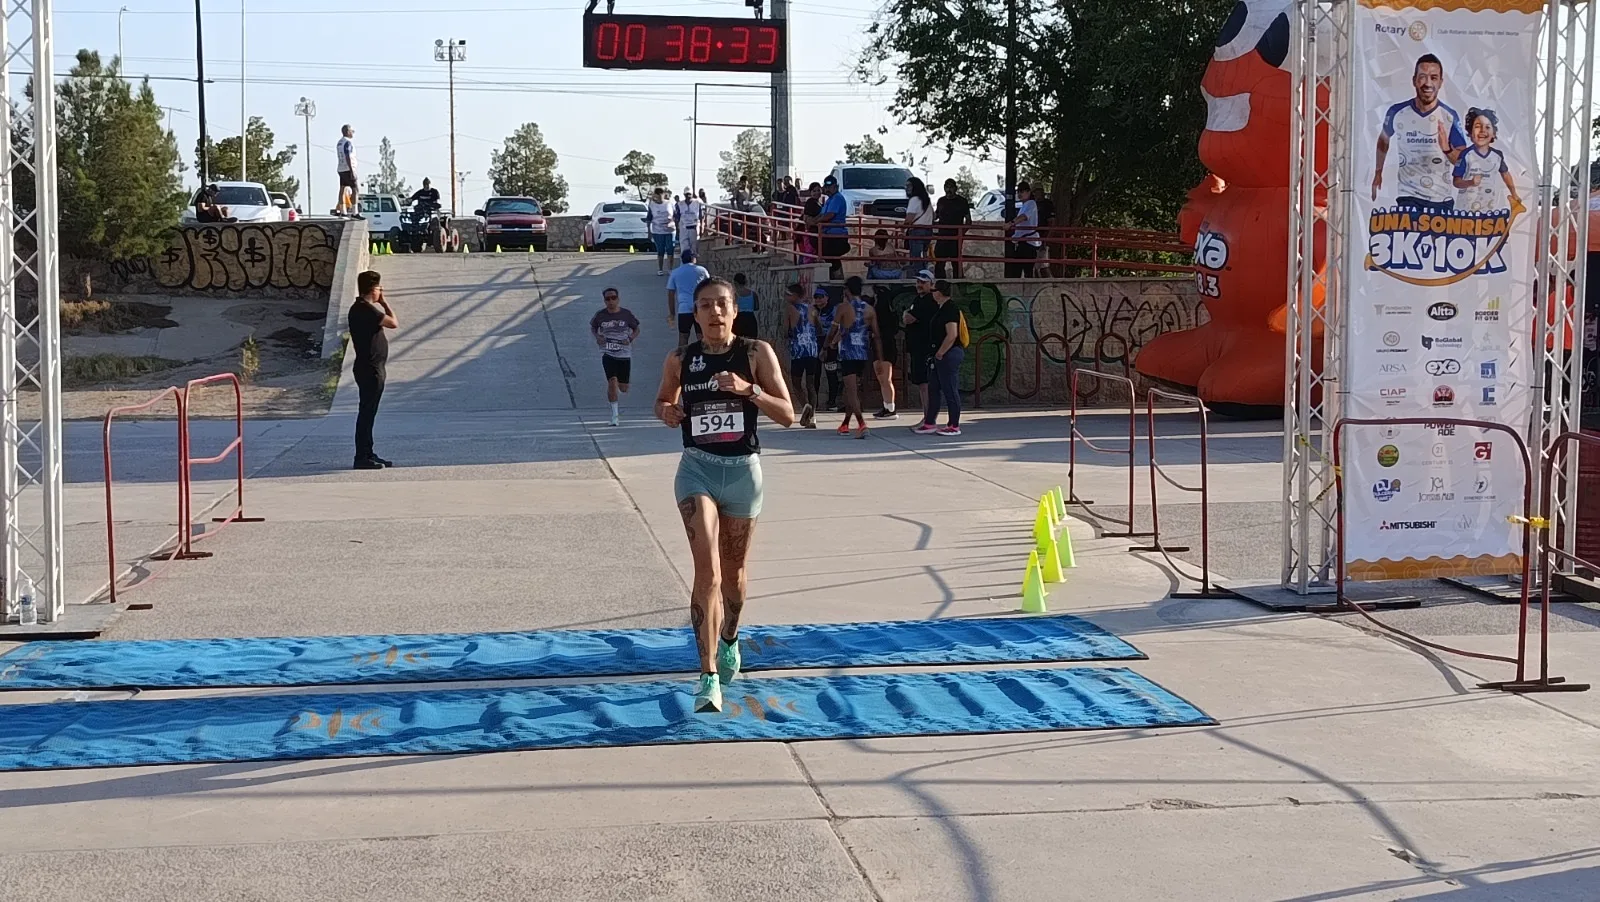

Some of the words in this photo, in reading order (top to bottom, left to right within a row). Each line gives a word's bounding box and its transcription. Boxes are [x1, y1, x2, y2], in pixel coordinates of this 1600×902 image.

[1375, 23, 1406, 36] Rotary
[596, 22, 647, 62] 00
[1372, 207, 1385, 215] LA
[1391, 205, 1417, 213] META
[1370, 213, 1412, 233] UNA
[1418, 215, 1506, 237] SONRISA
[1430, 307, 1455, 317] Altta
[1379, 363, 1407, 372] ARSA
[1426, 360, 1460, 376] exa
[1380, 388, 1407, 396] CIAP
[700, 414, 736, 434] 594
[1389, 521, 1437, 530] MITSUBISHI
